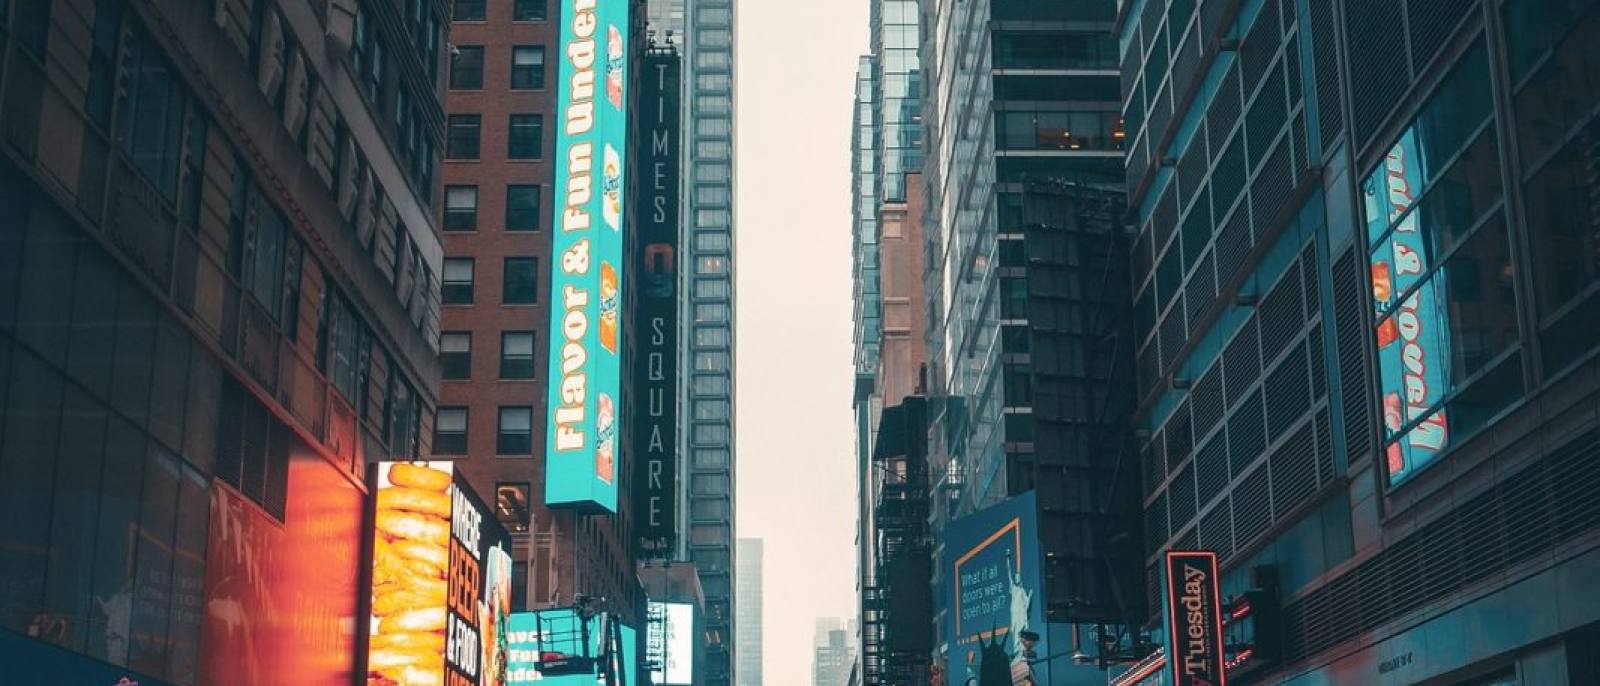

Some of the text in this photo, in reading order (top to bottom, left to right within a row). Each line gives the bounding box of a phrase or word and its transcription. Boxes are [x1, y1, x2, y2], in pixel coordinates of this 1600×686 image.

[651, 64, 669, 223] TIMES
[562, 143, 592, 232] Fun
[561, 237, 589, 274] &
[555, 285, 588, 451] Flavor
[648, 317, 665, 527] SQUARE
[452, 483, 482, 560] WHERE
[449, 537, 480, 627] BEER
[961, 571, 980, 587] What
[989, 564, 998, 580] all
[962, 582, 1003, 603] doors were
[962, 605, 981, 624] open
[447, 612, 478, 677] & FOOD
[1181, 563, 1206, 675] Tuesday
